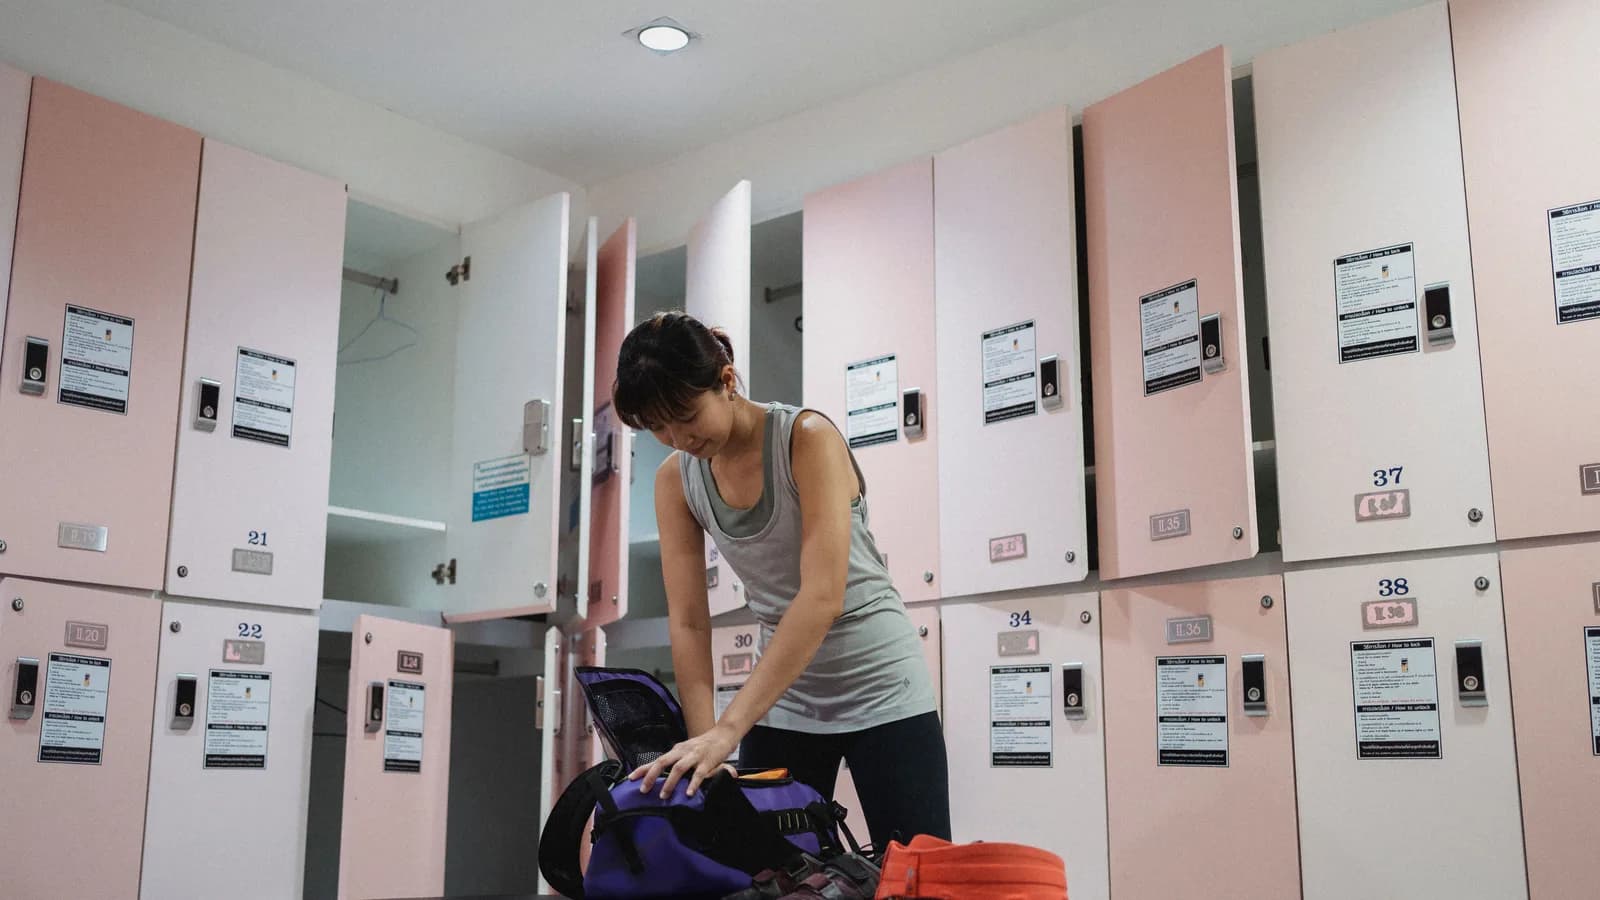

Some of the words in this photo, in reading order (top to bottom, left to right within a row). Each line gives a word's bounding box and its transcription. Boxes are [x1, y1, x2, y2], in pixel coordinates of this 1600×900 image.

[1373, 465, 1403, 487] 37
[247, 530, 268, 546] 21
[1379, 577, 1409, 597] 38
[1009, 610, 1032, 628] 34
[238, 622, 263, 639] 22
[734, 633, 753, 649] 30
